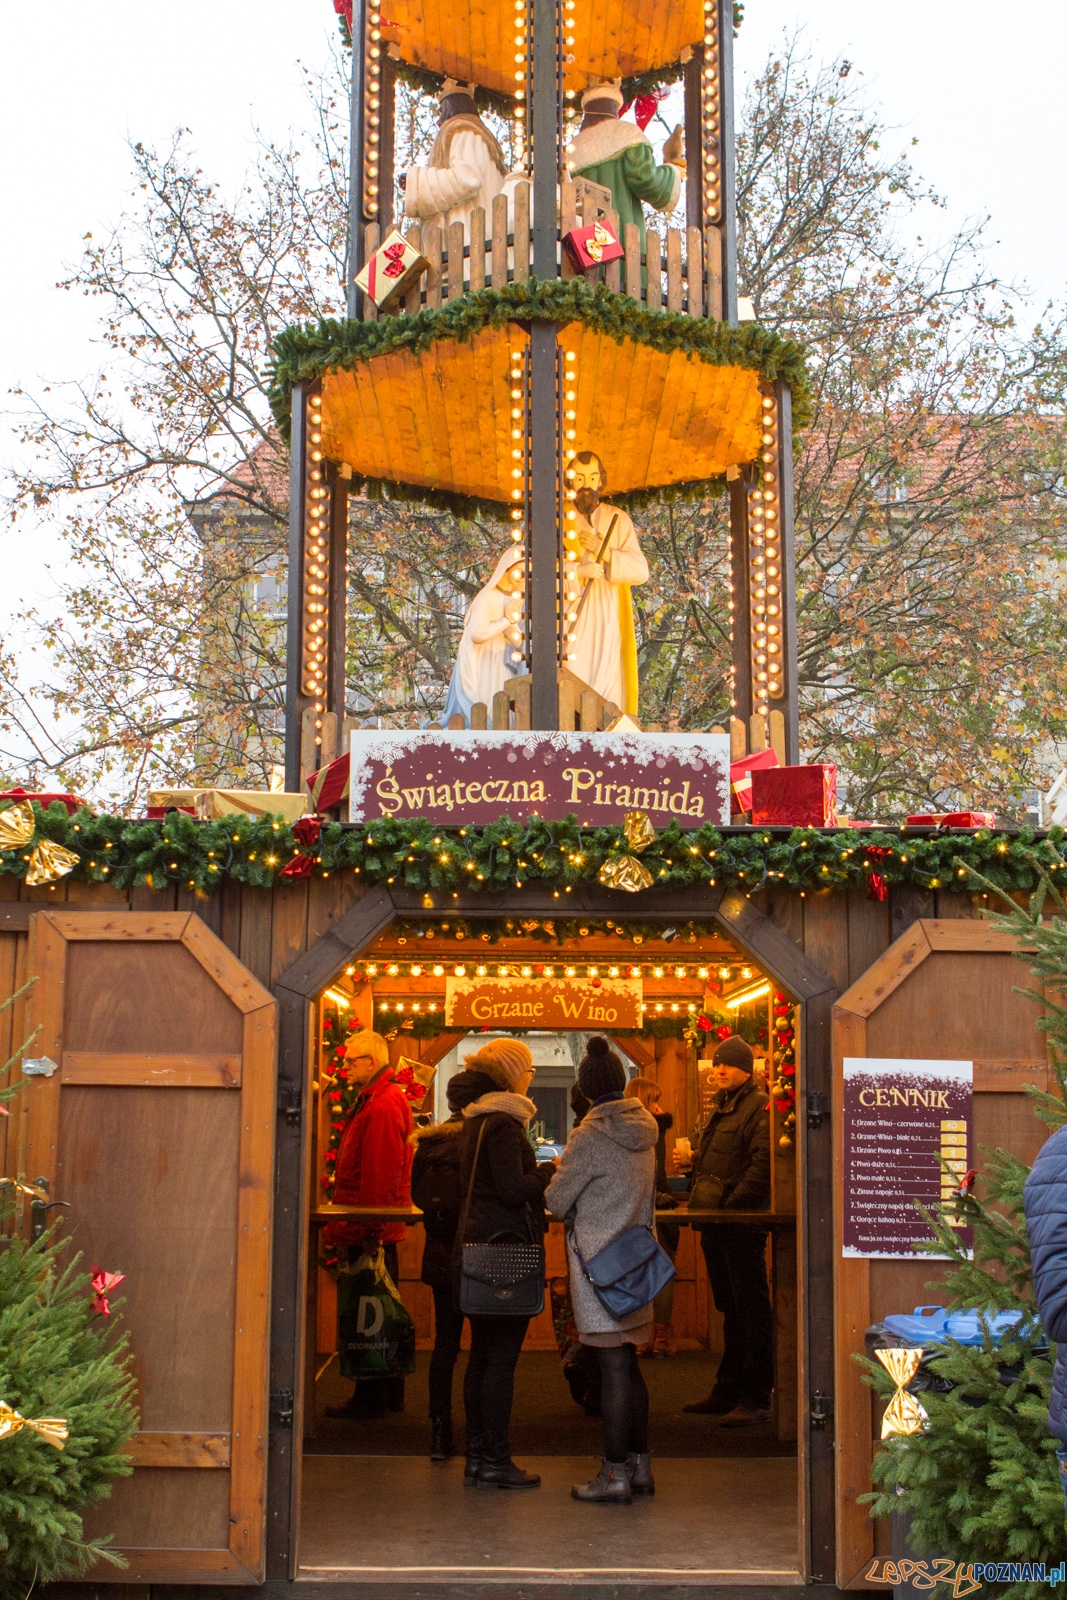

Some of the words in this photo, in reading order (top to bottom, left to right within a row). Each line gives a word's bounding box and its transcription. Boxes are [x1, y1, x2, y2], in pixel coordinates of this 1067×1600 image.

[376, 767, 546, 814] Świąteczna
[562, 767, 705, 818] Piramida
[471, 996, 544, 1019] Grzane
[553, 994, 617, 1022] Wino
[859, 1088, 951, 1109] CENNIK
[356, 1295, 384, 1337] D
